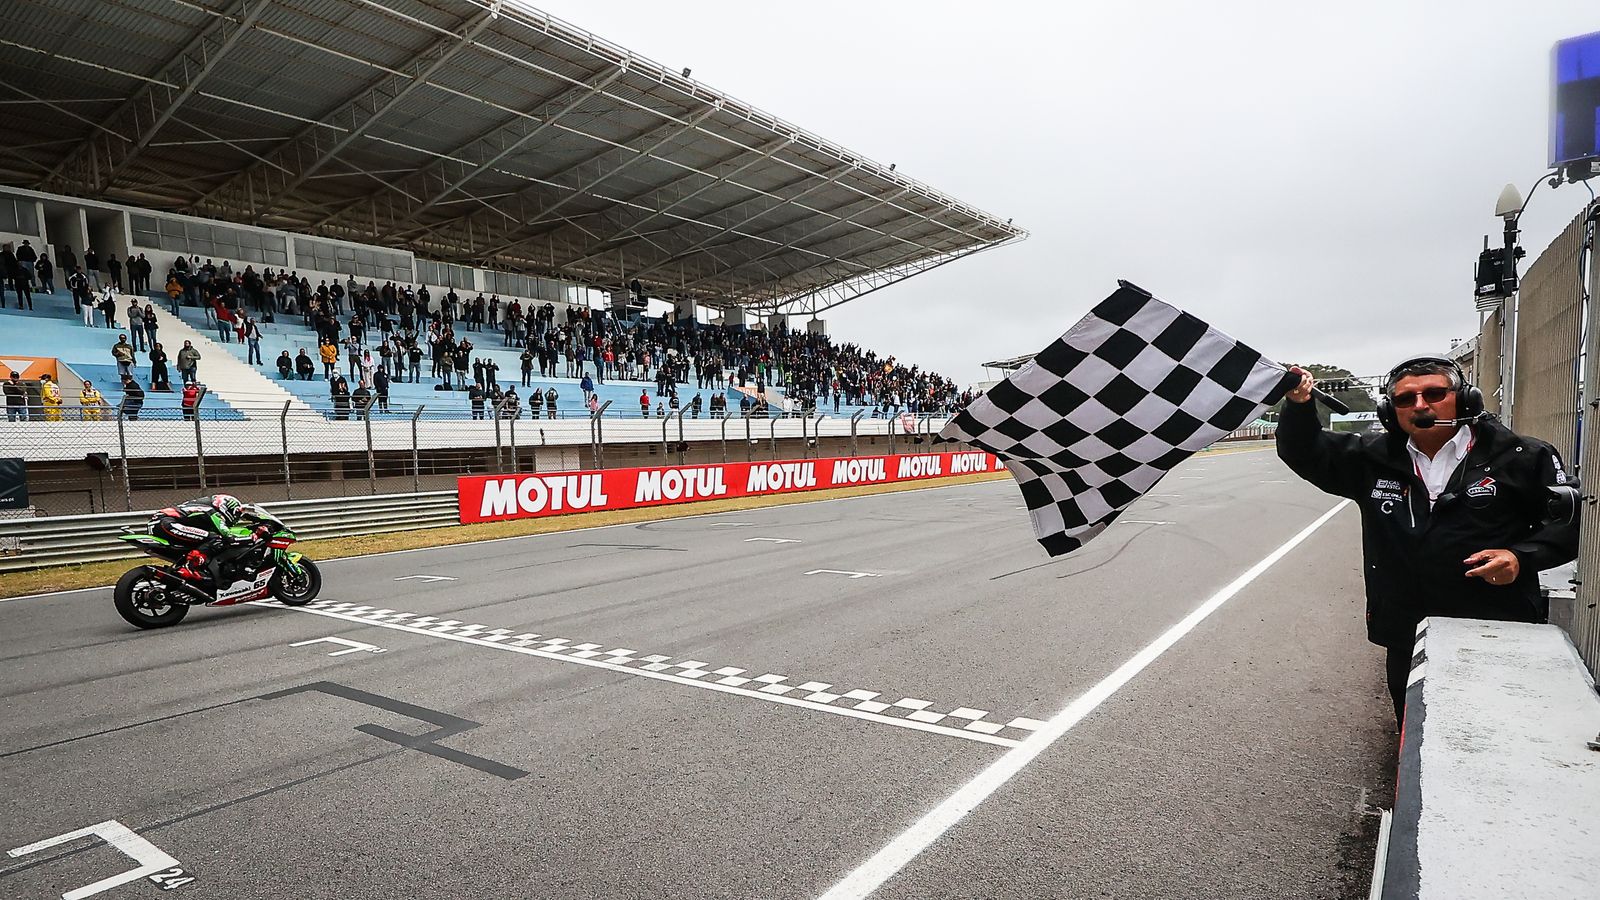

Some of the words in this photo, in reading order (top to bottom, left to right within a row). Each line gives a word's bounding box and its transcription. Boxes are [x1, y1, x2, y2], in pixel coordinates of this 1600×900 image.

[831, 458, 887, 484] MOTUL
[897, 455, 942, 478] MOTUL
[950, 452, 987, 474] MOTUL
[635, 467, 728, 503] MOTUL
[746, 461, 817, 492] MOTUL
[479, 474, 608, 517] MOTUL
[253, 579, 266, 590] 65
[149, 868, 196, 890] 24
